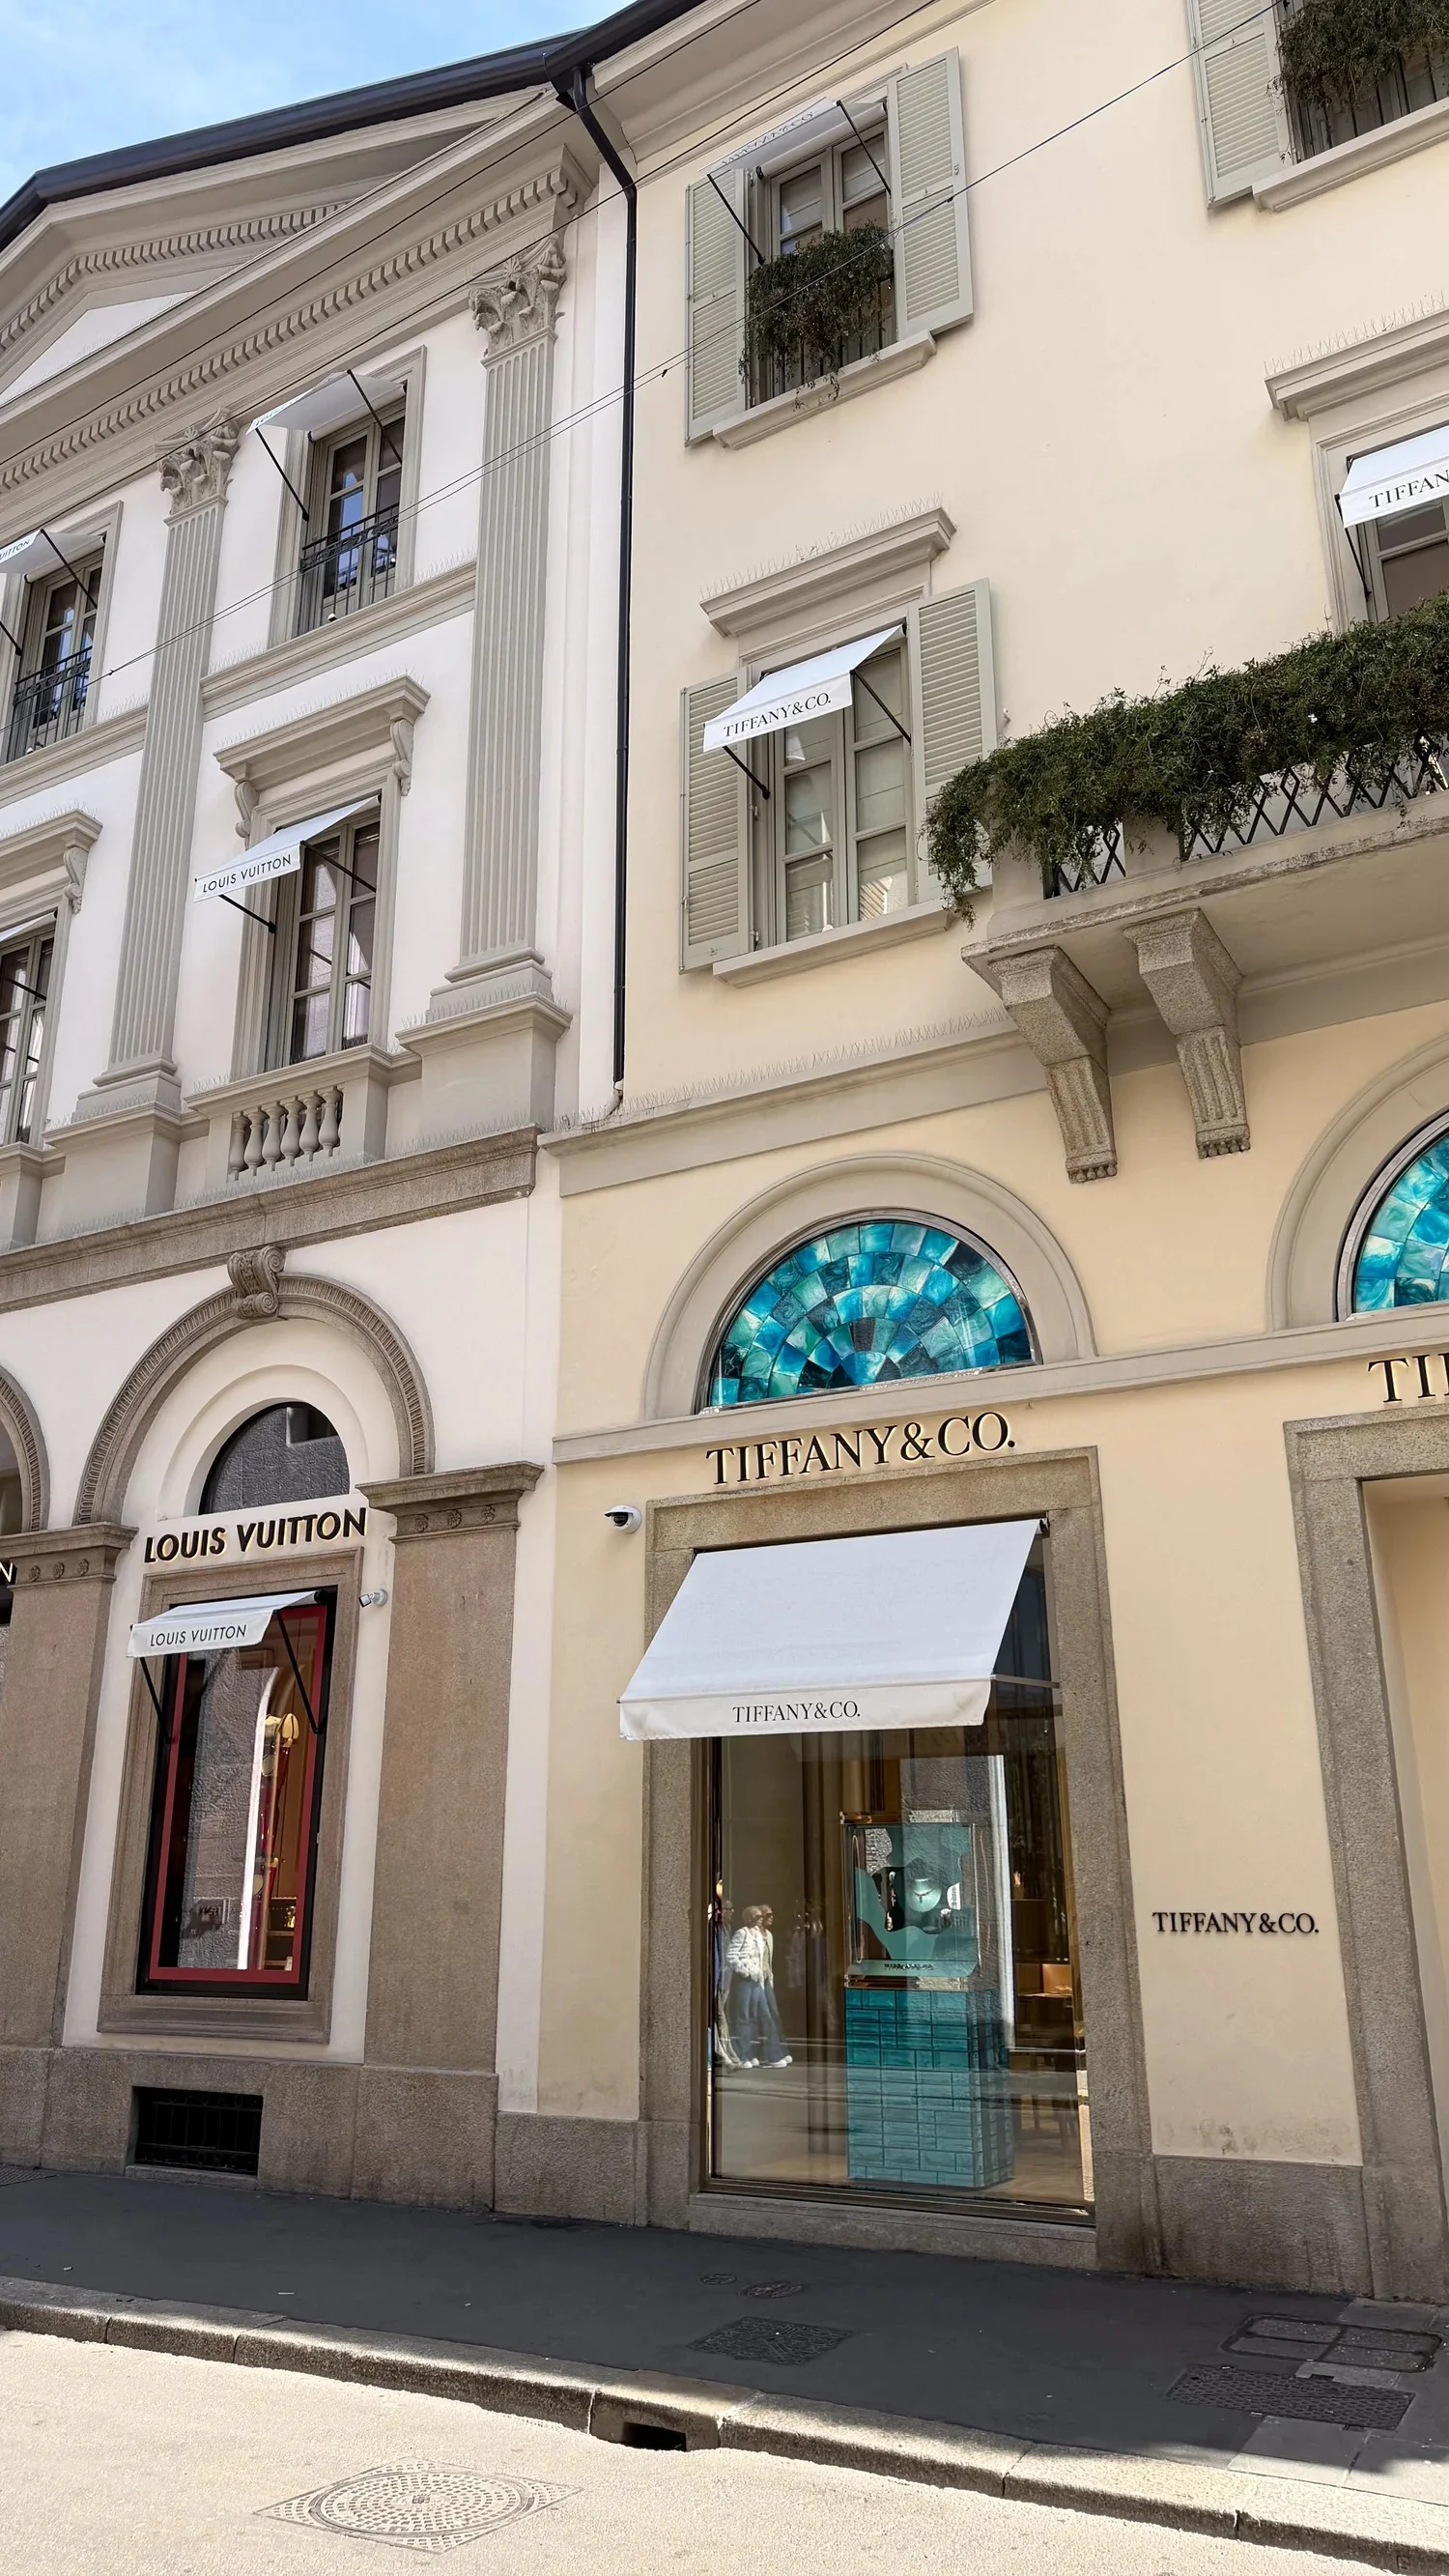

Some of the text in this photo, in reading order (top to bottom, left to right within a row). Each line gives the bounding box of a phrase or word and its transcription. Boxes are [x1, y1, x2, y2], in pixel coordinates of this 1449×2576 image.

[1368, 470, 1449, 507] TIFFAN
[723, 692, 832, 737] TIFFANY&CO.
[203, 854, 292, 893] LOUIS VUITTON
[705, 1412, 1016, 1485] TIFFANY&CO.
[144, 1507, 367, 1563] LOUIS VUITTON
[150, 1624, 247, 1646] LOUIS VUITTON
[732, 1701, 861, 1723] TIFFANY&CO.
[1151, 1912, 1320, 1933] TIFFANY&CO.
